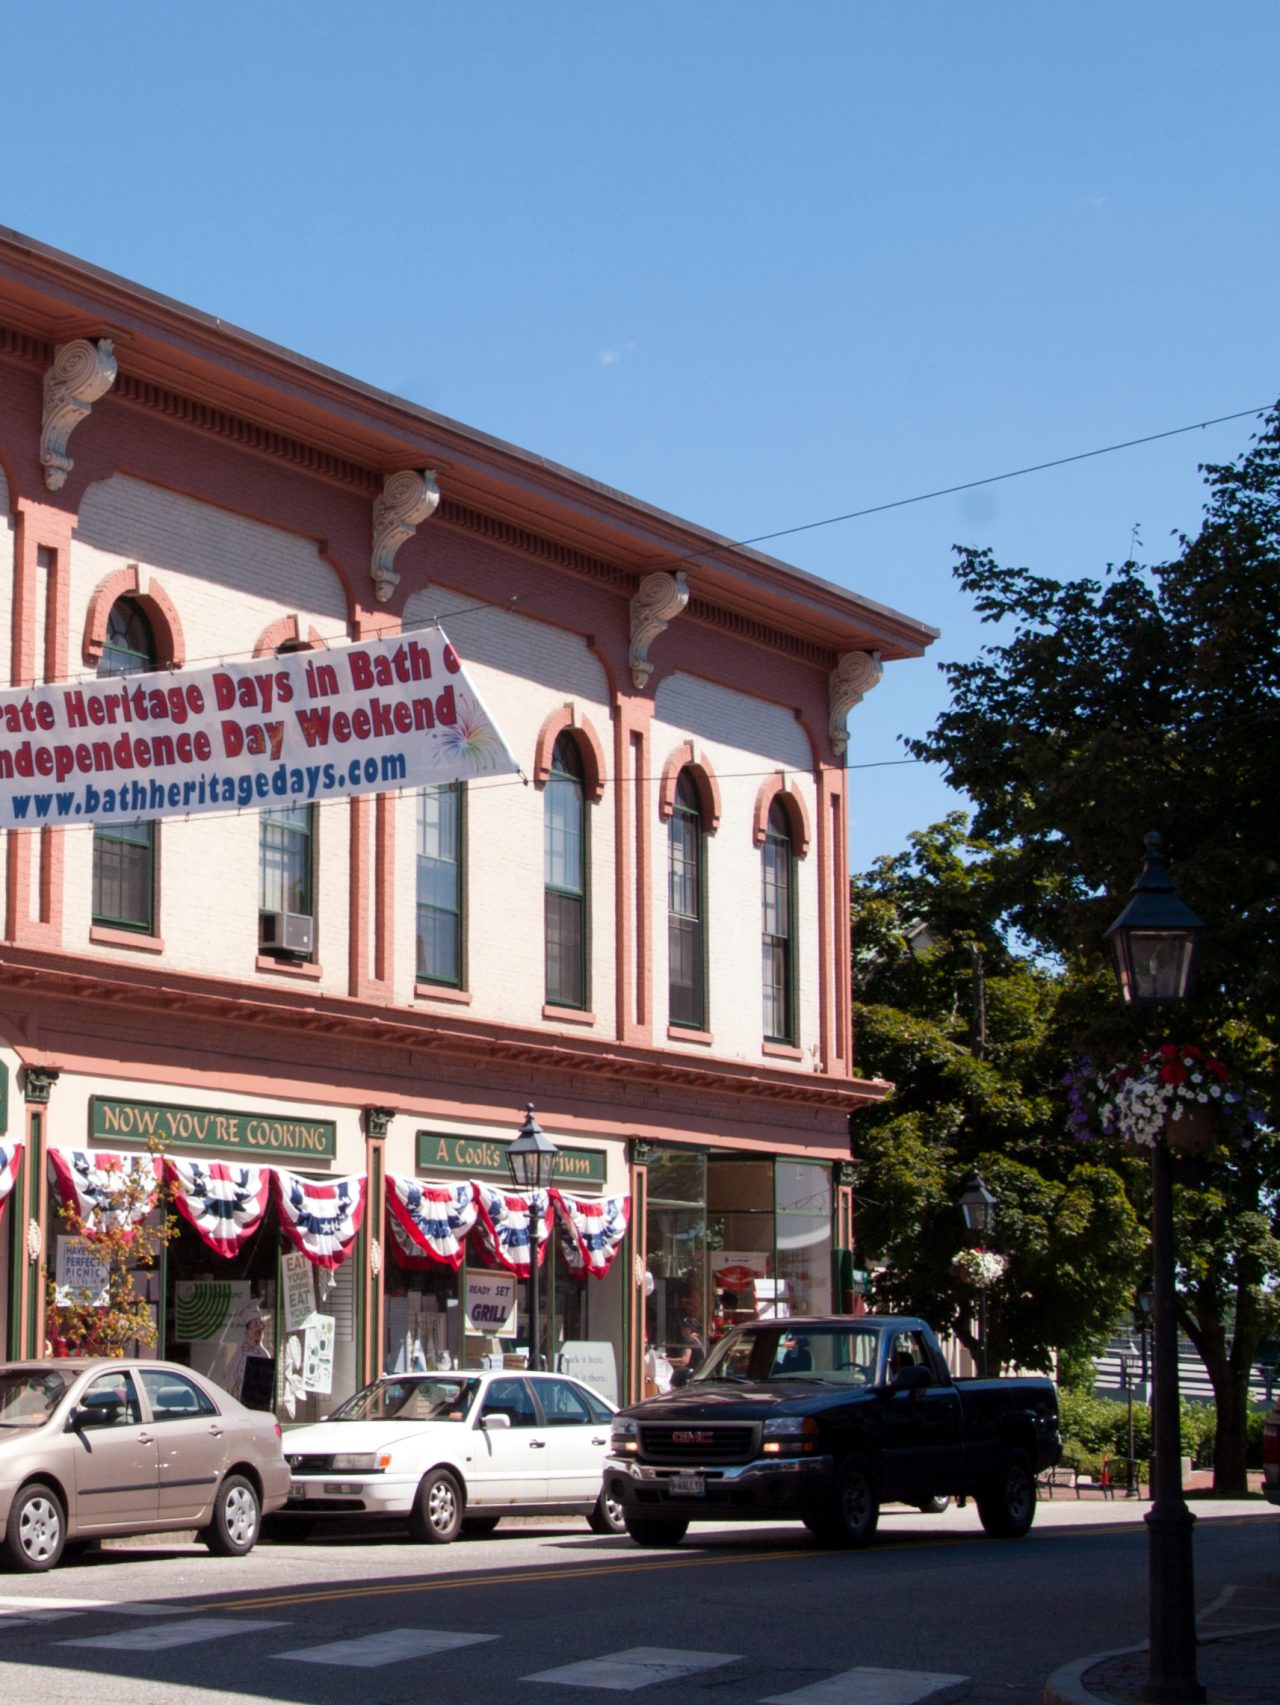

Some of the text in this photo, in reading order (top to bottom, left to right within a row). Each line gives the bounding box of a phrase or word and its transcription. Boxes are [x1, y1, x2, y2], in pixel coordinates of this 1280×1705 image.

[63, 682, 205, 729] Heritage
[212, 669, 294, 714] Days
[304, 658, 340, 699] in
[347, 641, 432, 692] Bath
[220, 719, 285, 761] Day
[295, 684, 457, 748] Weekend
[11, 752, 407, 820] www.bathheritagedays.com
[103, 1105, 327, 1151] NOW YOU'RE COOKING
[436, 1138, 450, 1161] A
[455, 1139, 501, 1167] Cook's
[65, 1268, 101, 1277] PICNIC
[286, 1255, 307, 1272] EAT
[287, 1271, 308, 1283] YOUR
[289, 1290, 311, 1308] EAT
[469, 1284, 511, 1296] READY SET
[471, 1303, 507, 1323] GRILL
[672, 1431, 714, 1443] GMC
